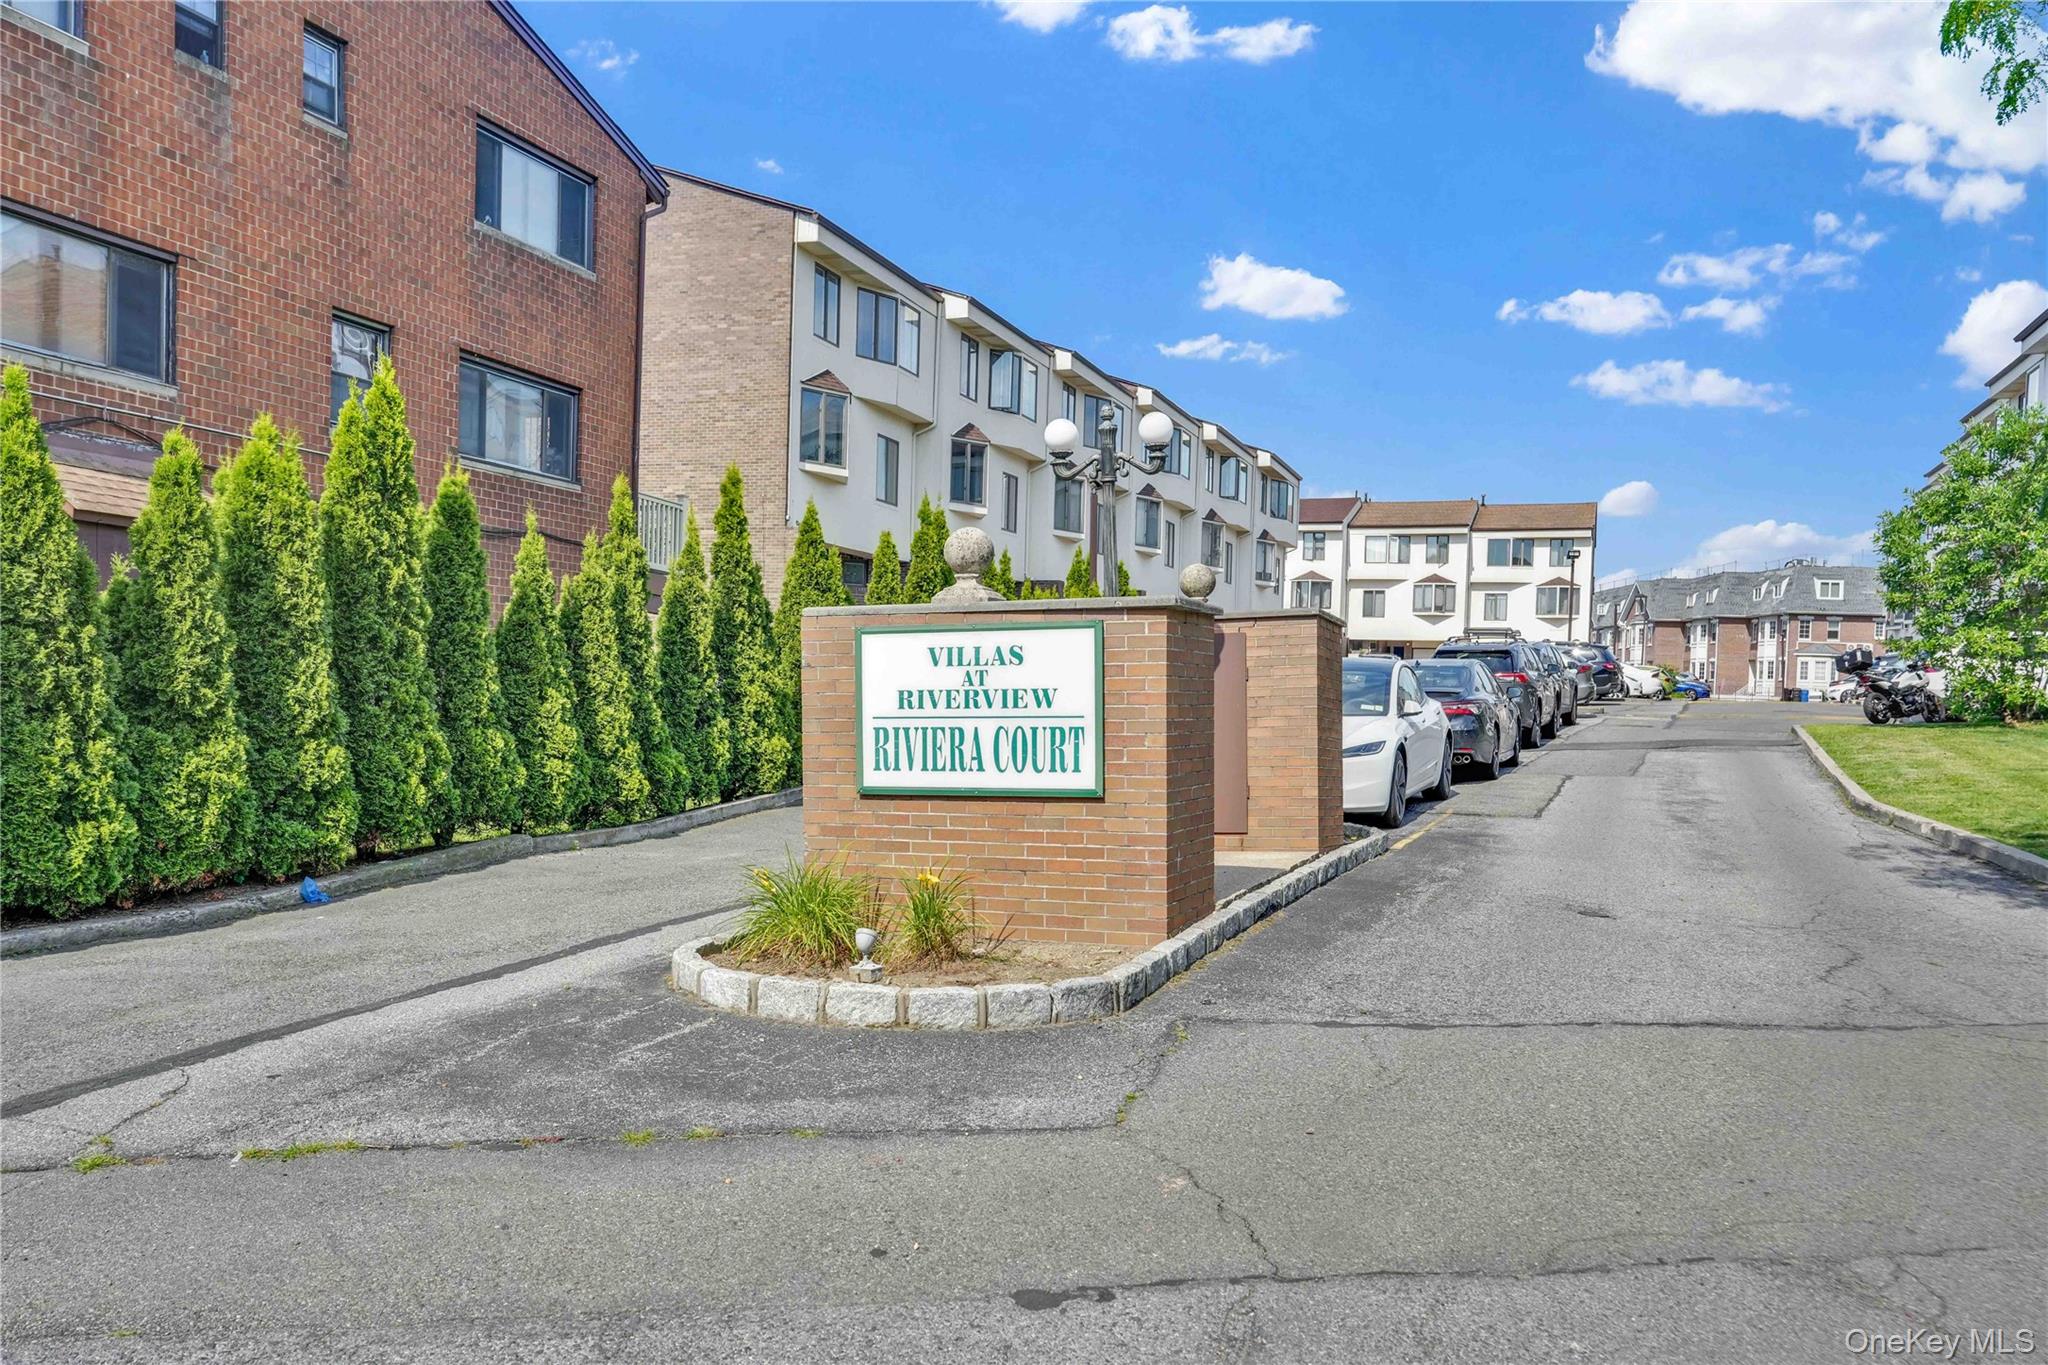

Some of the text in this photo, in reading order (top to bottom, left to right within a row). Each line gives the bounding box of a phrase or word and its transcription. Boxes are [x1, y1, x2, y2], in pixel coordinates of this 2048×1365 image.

[928, 645, 1024, 667] VILLAS
[961, 670, 989, 687] AT
[897, 688, 1058, 710] RIVERVIEW
[873, 725, 1085, 773] RIVIERA COURT
